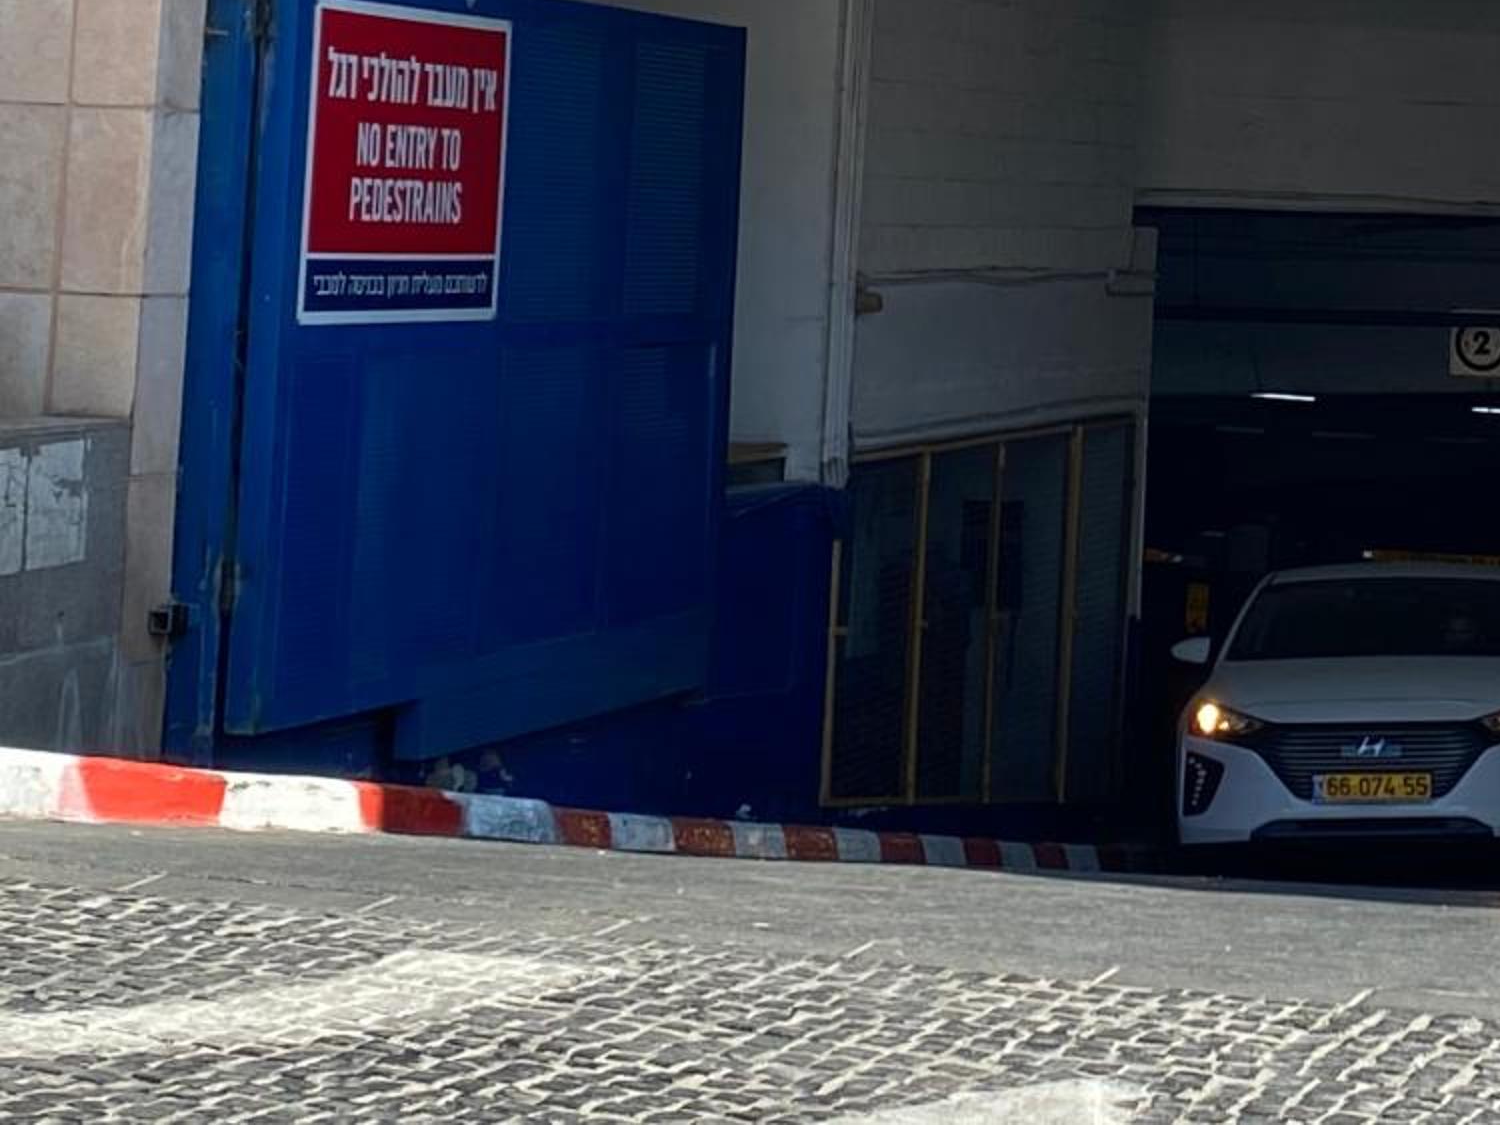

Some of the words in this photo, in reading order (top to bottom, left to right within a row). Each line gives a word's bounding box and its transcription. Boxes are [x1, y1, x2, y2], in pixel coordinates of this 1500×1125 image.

[327, 45, 359, 100] רגל
[361, 51, 421, 106] להולכי
[424, 62, 470, 110] מעבר
[472, 67, 498, 114] אין
[356, 122, 381, 167] NO
[384, 124, 438, 170] ENTRY
[441, 128, 462, 172] TO
[348, 176, 463, 225] PEDESTRAINS
[1473, 330, 1491, 356] 2
